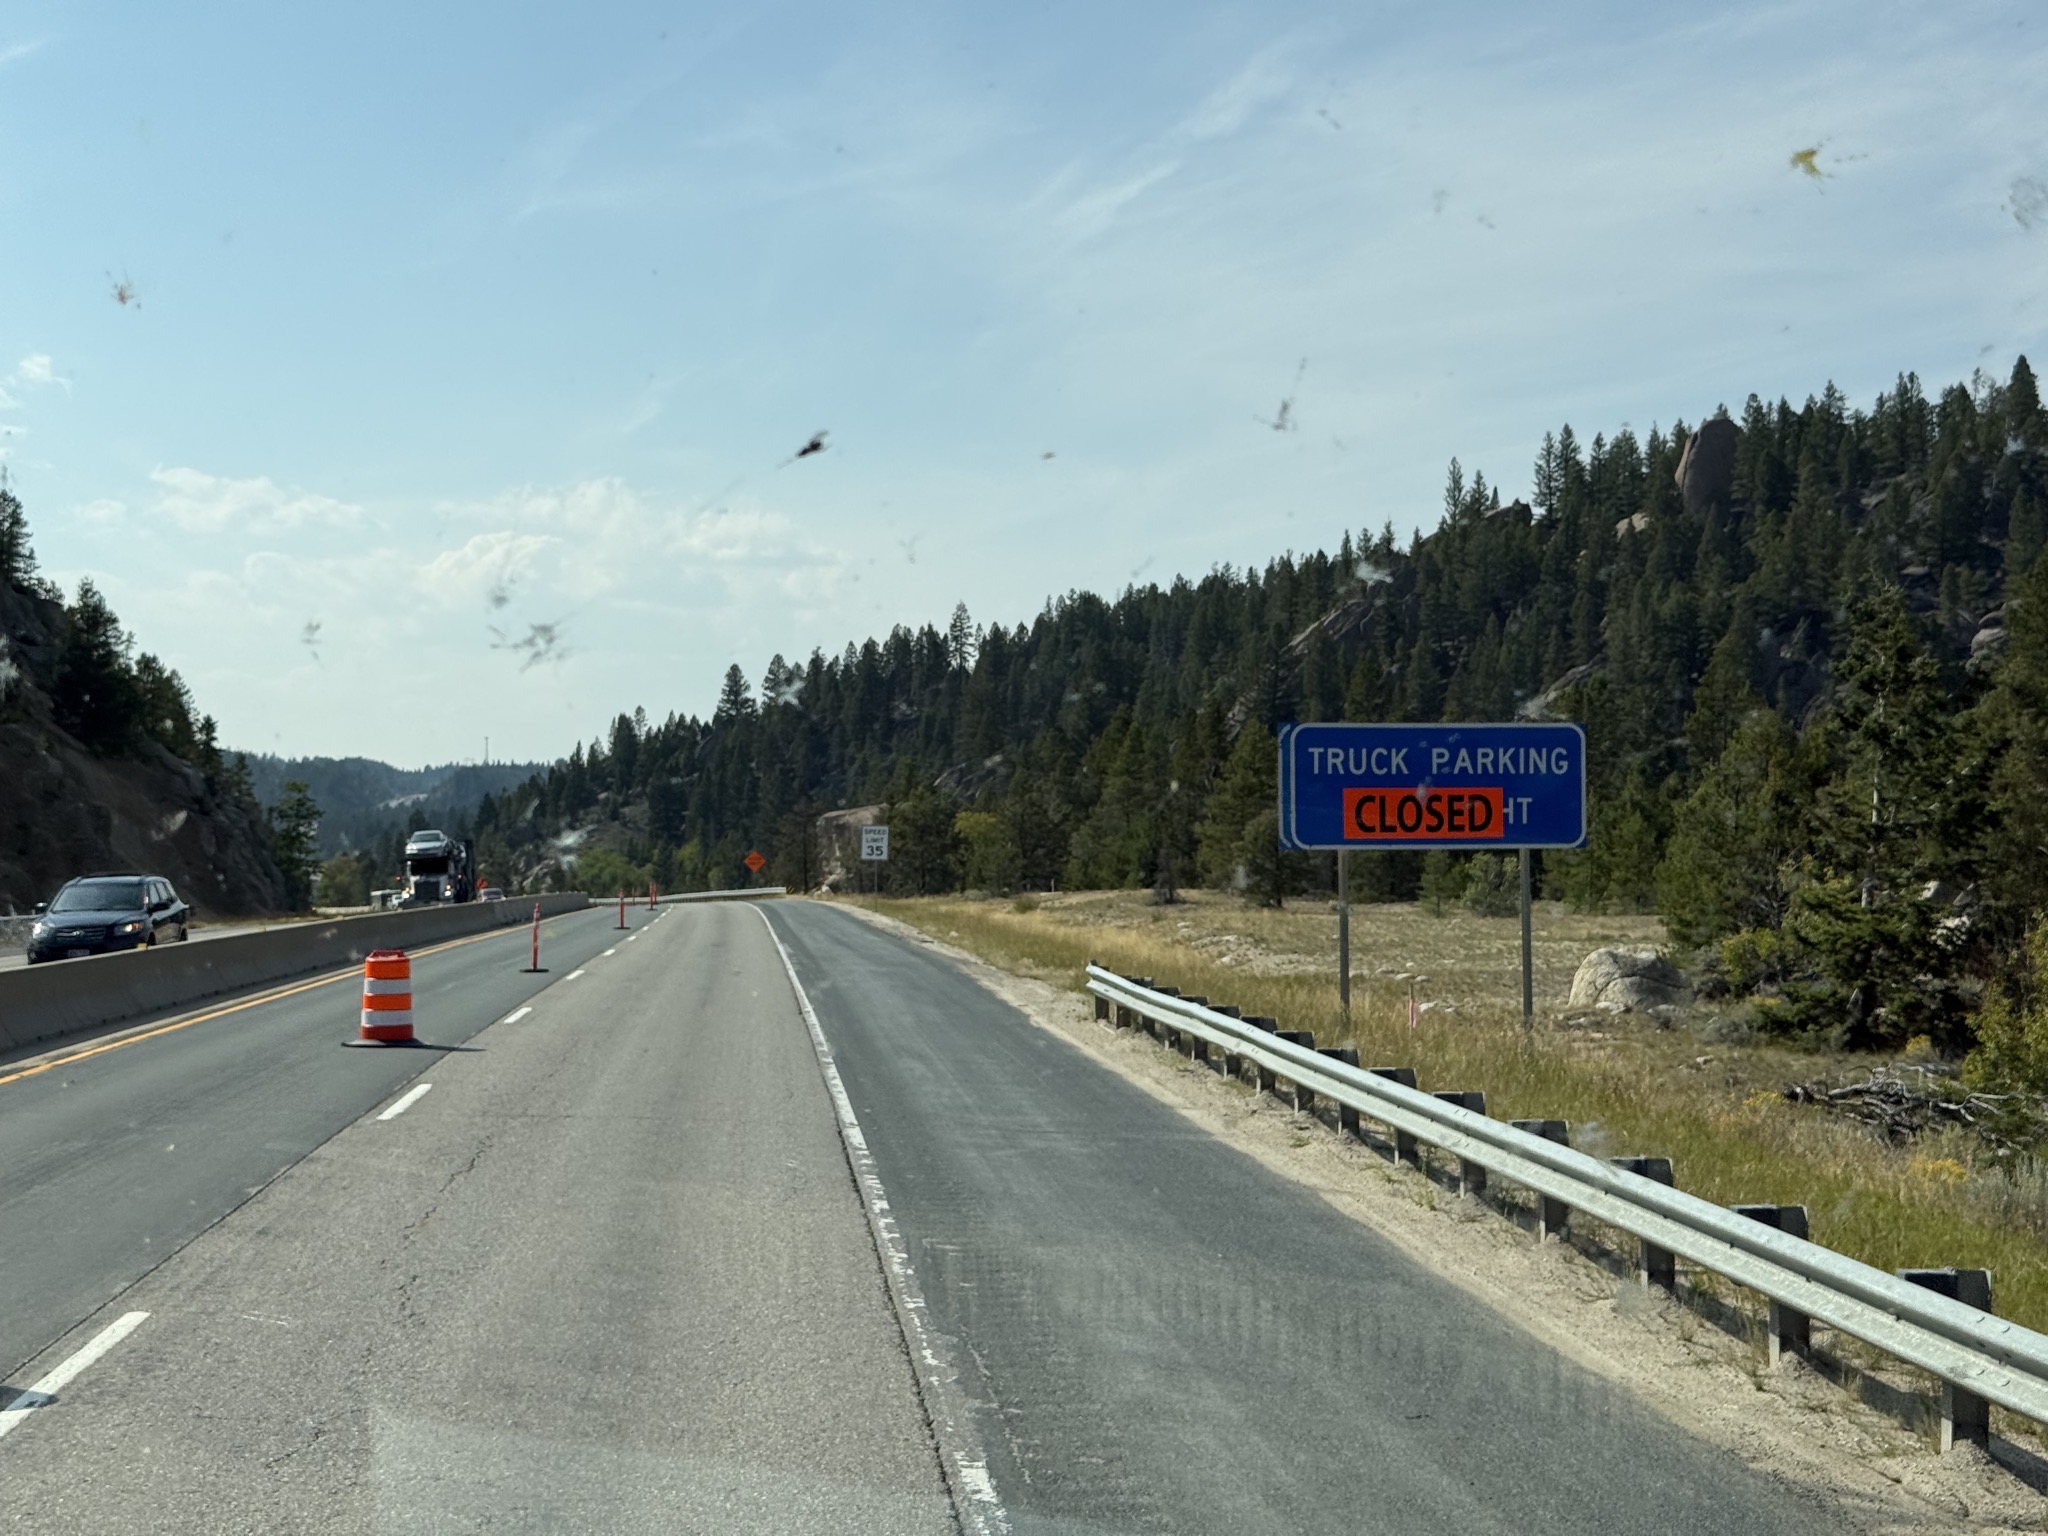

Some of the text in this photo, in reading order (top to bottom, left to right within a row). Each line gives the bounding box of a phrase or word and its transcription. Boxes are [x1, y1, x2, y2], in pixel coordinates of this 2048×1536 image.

[1308, 747, 1569, 775] TRUCK PARKING
[1354, 794, 1493, 833] CLOSED
[866, 845, 884, 856] 35
